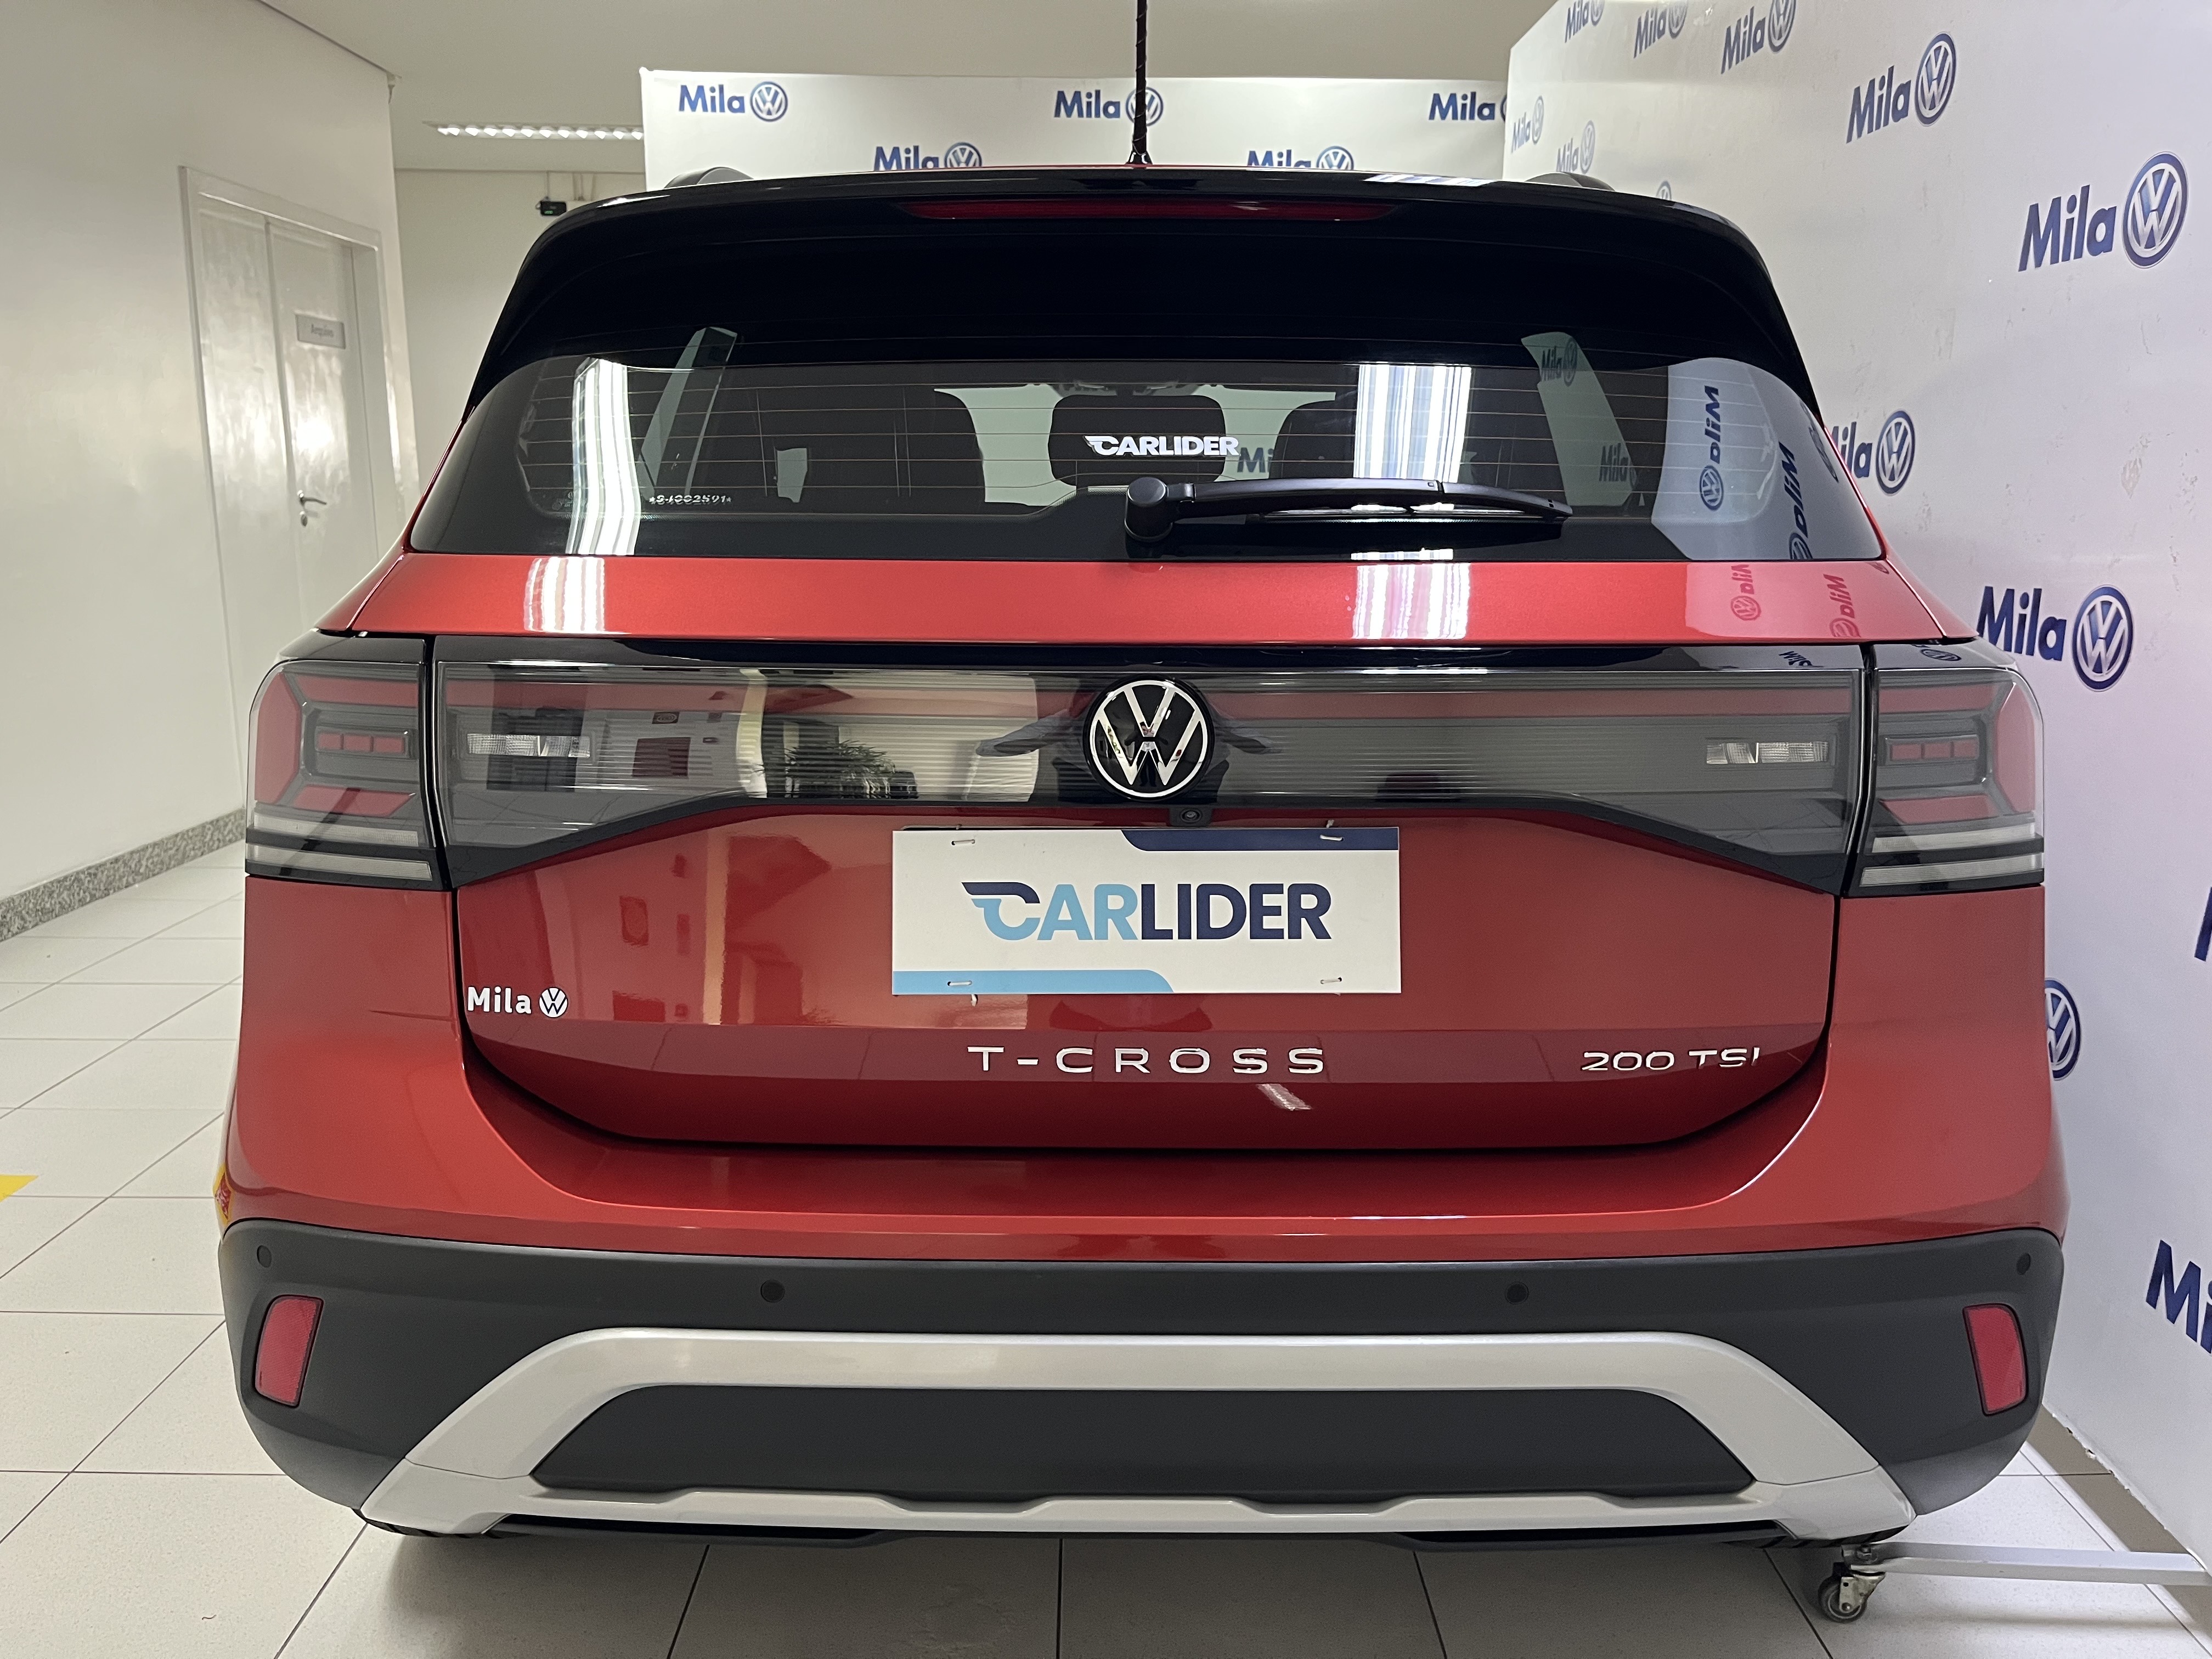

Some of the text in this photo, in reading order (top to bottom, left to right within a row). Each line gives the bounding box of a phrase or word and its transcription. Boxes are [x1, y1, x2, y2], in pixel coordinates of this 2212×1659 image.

[1565, 2, 1589, 43] Mila
[1634, 8, 1666, 58] Mila
[1721, 6, 1766, 74] Mila
[679, 84, 745, 113] Mila
[1054, 89, 1120, 119] Mila
[1429, 92, 1495, 120] Mila
[1846, 65, 1911, 144] Mila
[874, 145, 939, 171] Mila
[1556, 138, 1579, 172] Mila
[2018, 184, 2117, 272] Mila
[1084, 436, 1239, 456] CARLIDER
[1831, 421, 1872, 478] ila
[1976, 586, 2067, 661] Mila
[961, 881, 1331, 940] CARLIDER
[467, 986, 532, 1014] Mila
[967, 1046, 1324, 1075] T-CROSS
[1582, 1047, 1760, 1071] 200 TSI
